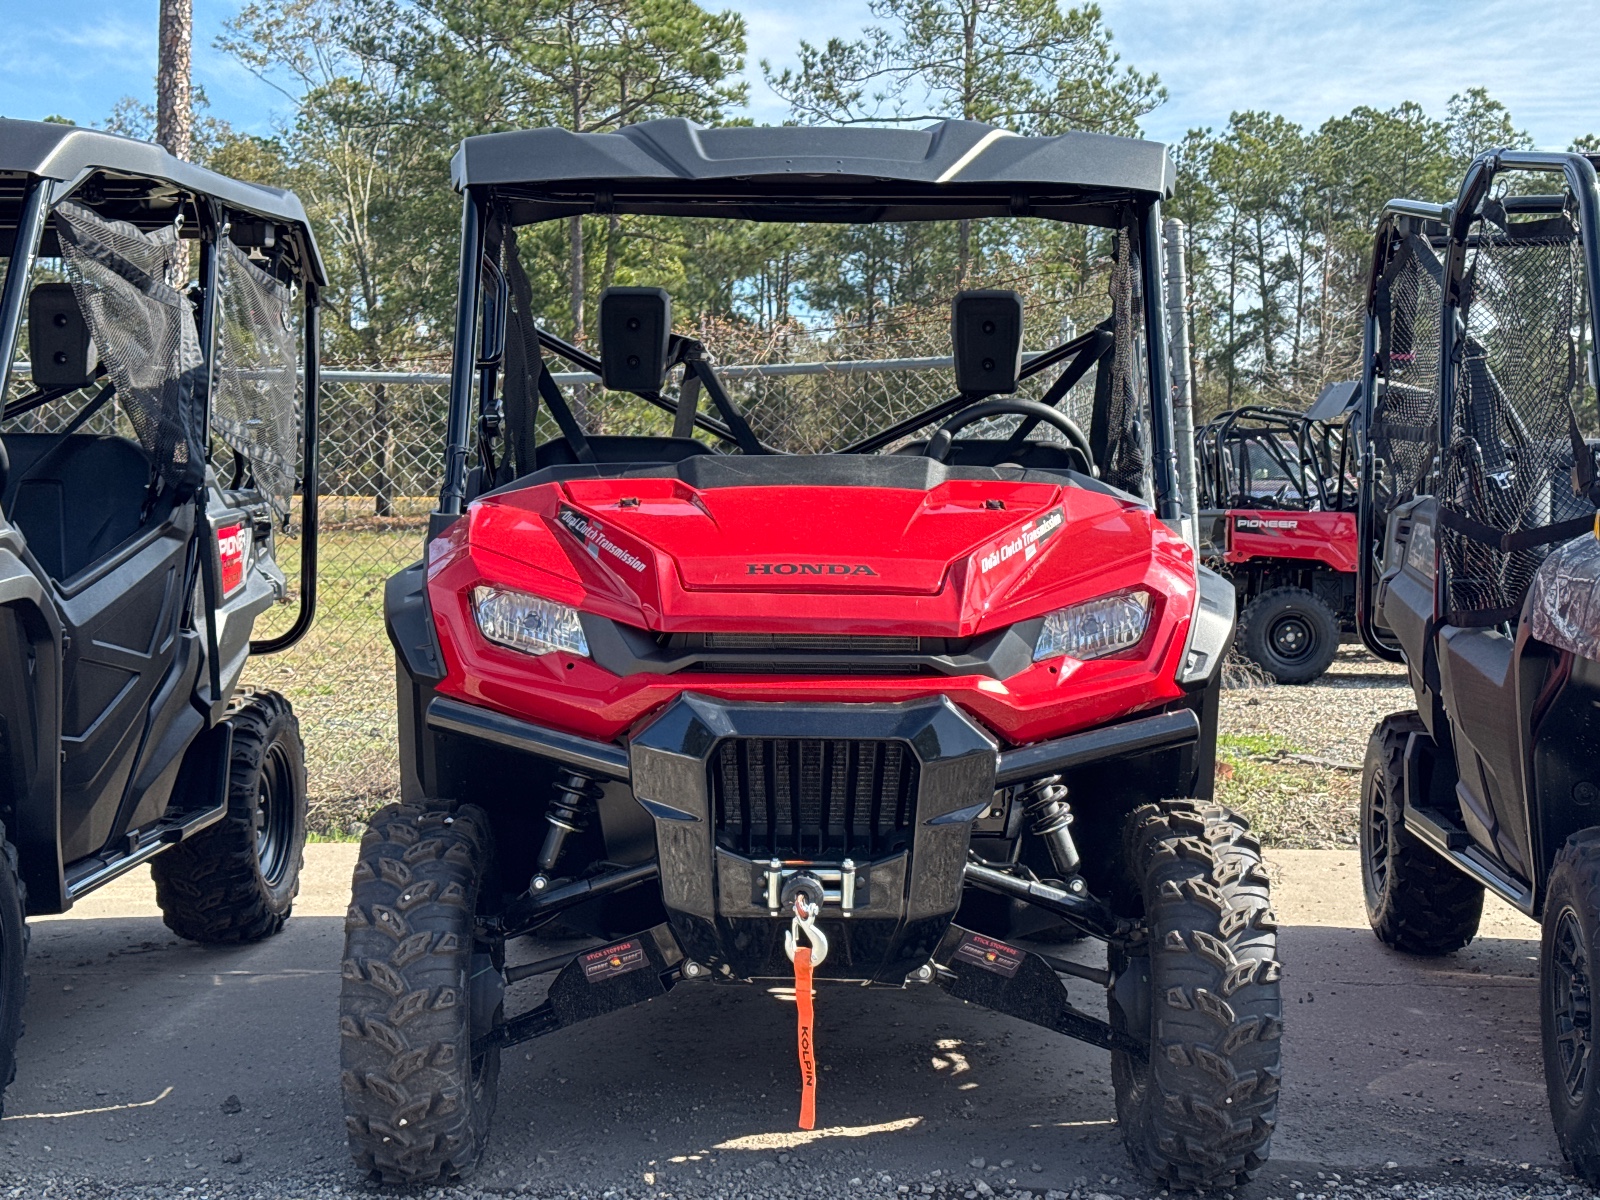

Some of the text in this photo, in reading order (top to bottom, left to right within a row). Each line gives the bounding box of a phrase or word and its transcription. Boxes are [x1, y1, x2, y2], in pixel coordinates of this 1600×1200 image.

[1237, 519, 1298, 528] PIONEER
[561, 510, 647, 573] Dual Clutch Transmission
[981, 513, 1062, 574] Dual Clutch Transmission
[746, 563, 879, 576] HONDA
[586, 942, 632, 961] STICK STOPPERS
[973, 936, 1018, 955] STICK STOPPERS
[801, 1026, 813, 1087] KOLPIN
